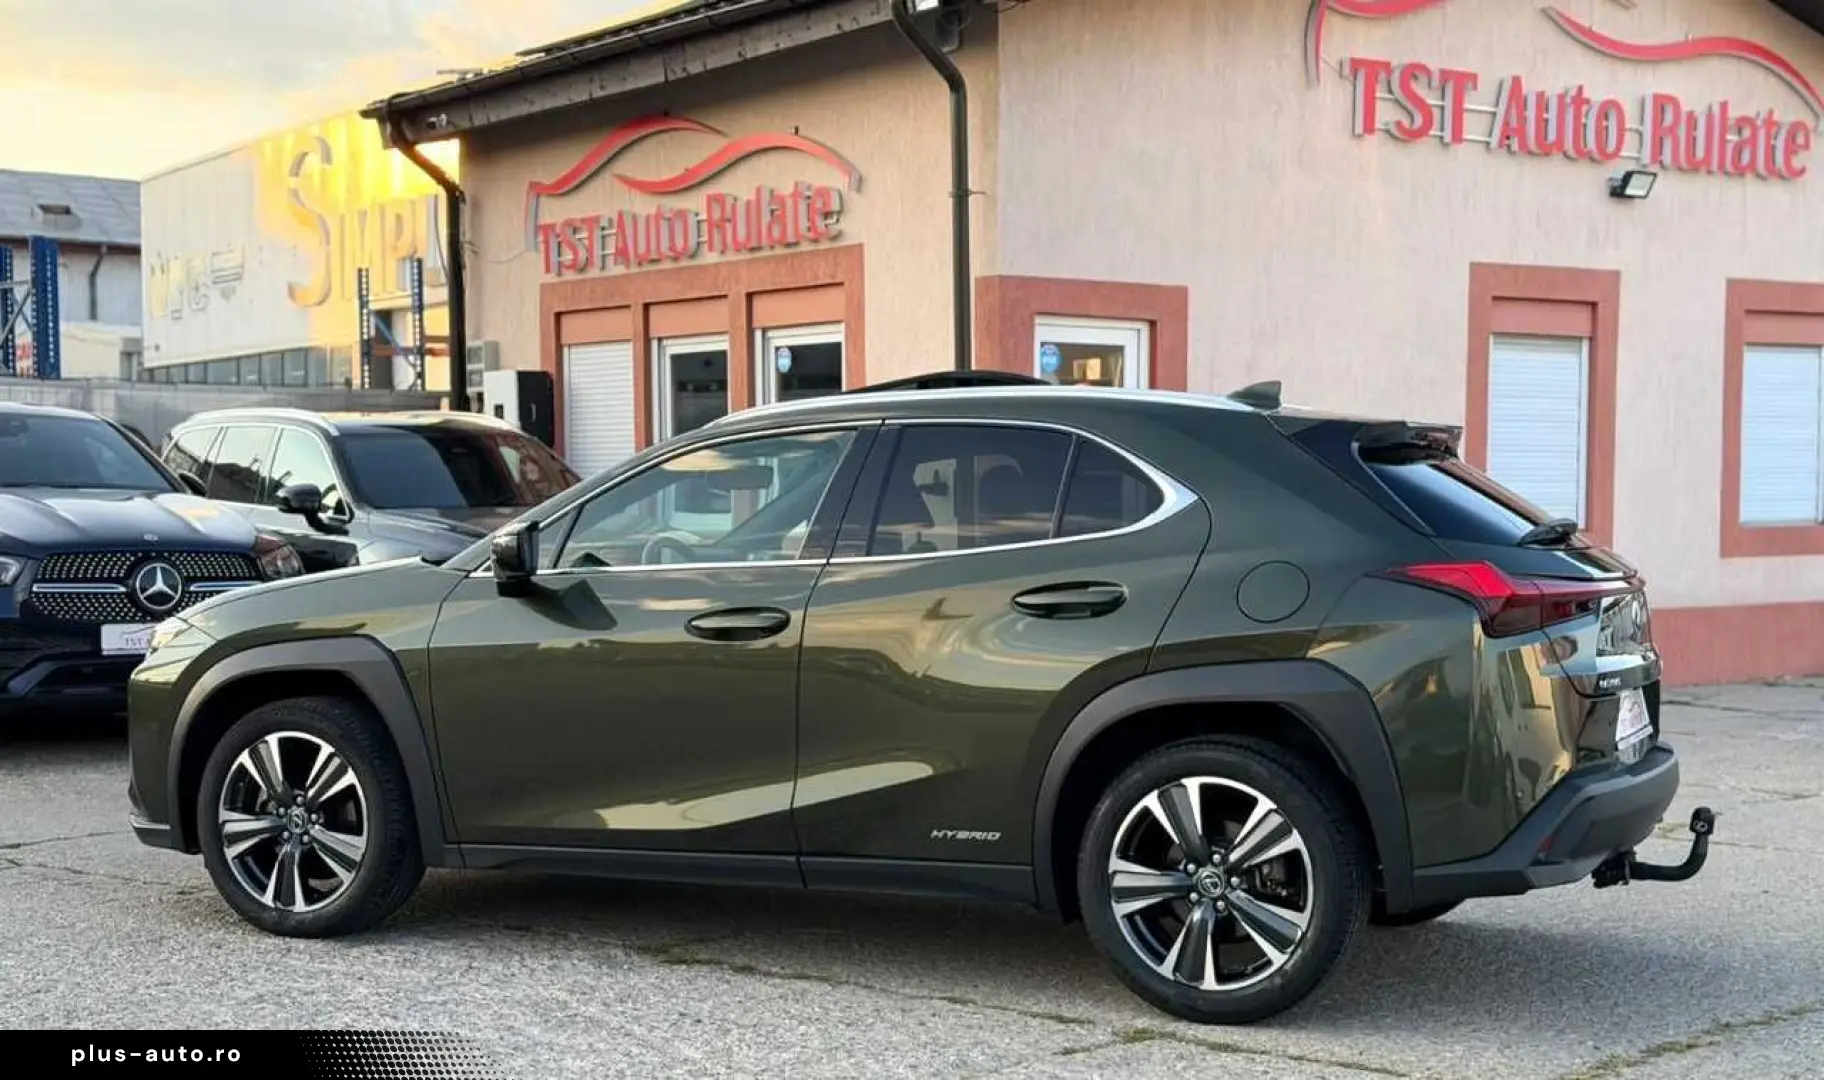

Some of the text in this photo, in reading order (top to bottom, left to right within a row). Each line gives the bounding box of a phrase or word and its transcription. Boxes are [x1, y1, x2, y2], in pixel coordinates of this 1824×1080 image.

[1342, 57, 1812, 179] TST Auto Rulate
[538, 181, 844, 275] TST Auto Rulate
[930, 829, 1002, 840] HYBRID
